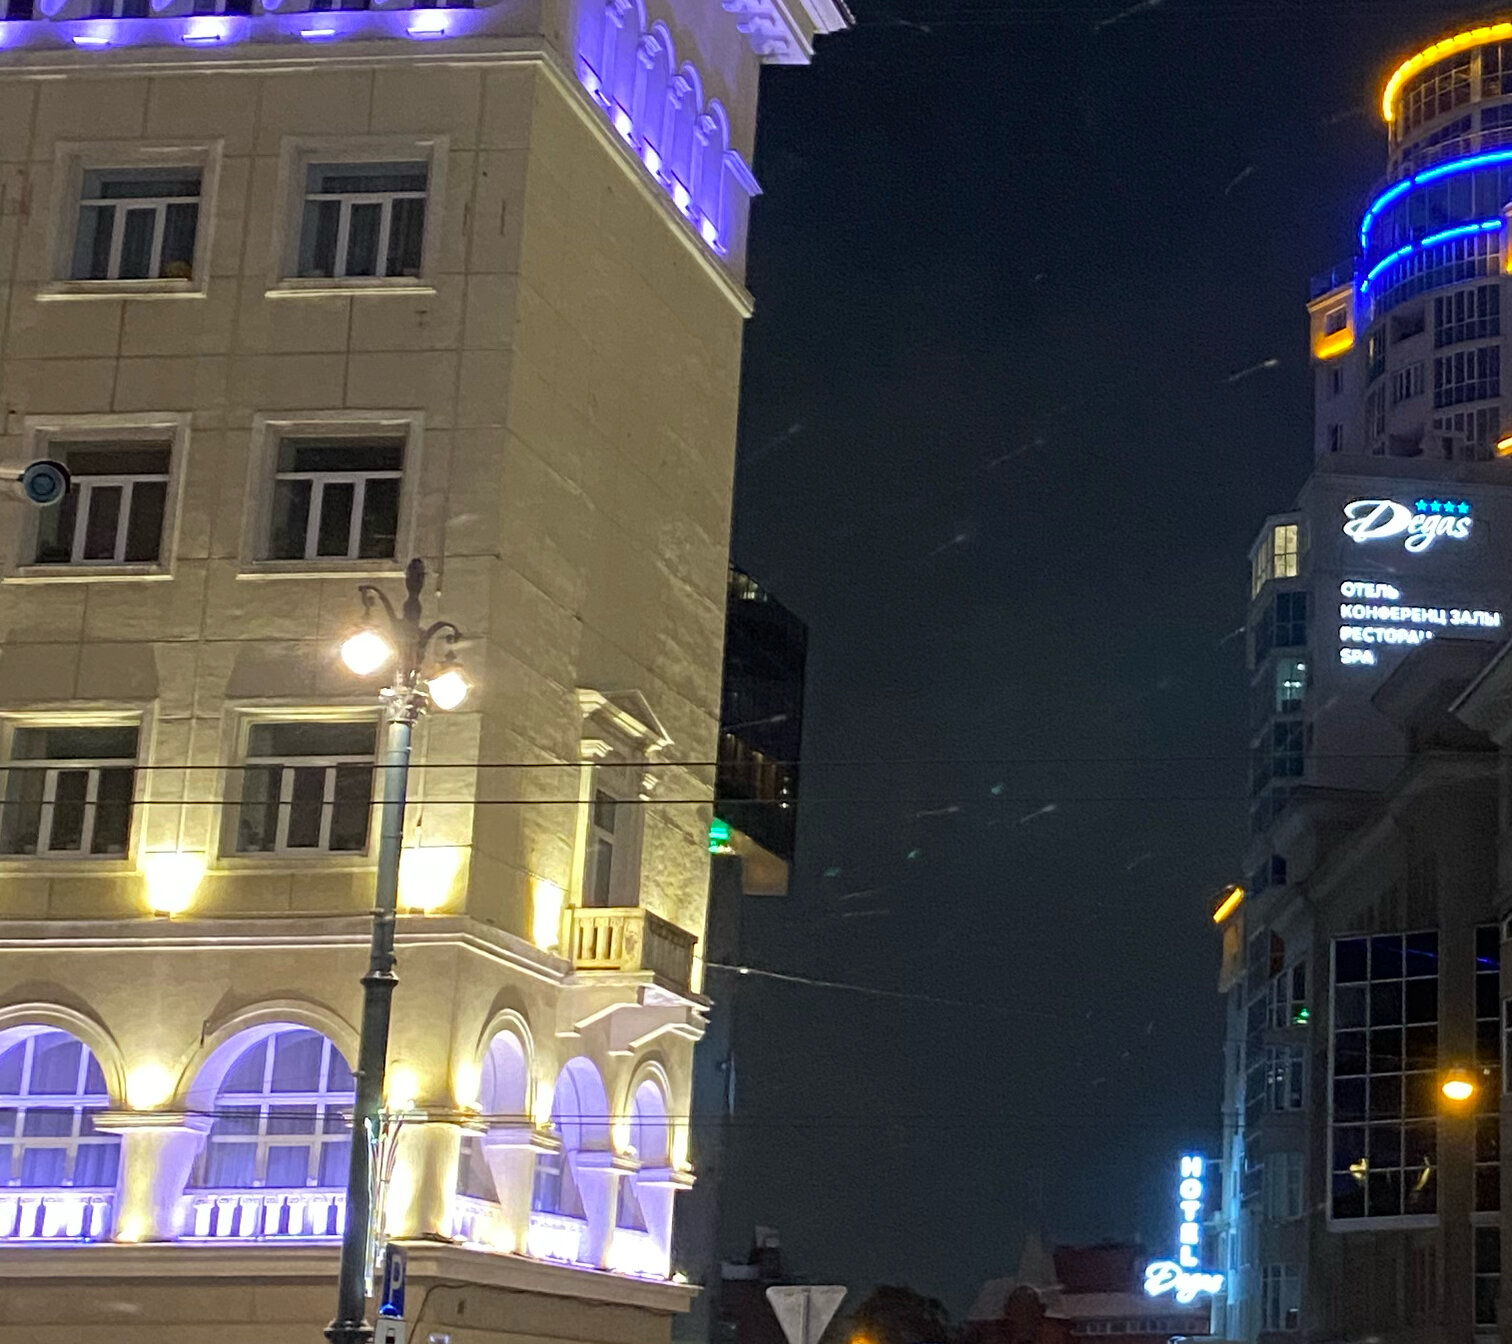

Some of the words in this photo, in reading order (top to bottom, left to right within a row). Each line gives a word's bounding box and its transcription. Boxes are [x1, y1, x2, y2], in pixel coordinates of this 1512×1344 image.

[1343, 499, 1473, 552] Degas
[1340, 581, 1400, 599] ОТЕЛЬ
[1340, 604, 1447, 626] КОНФЕРЕНЦ
[1449, 609, 1502, 627] ЗАЛЫ
[1339, 647, 1375, 665] SPA
[1179, 1155, 1202, 1268] HOTEL
[388, 1253, 403, 1304] P
